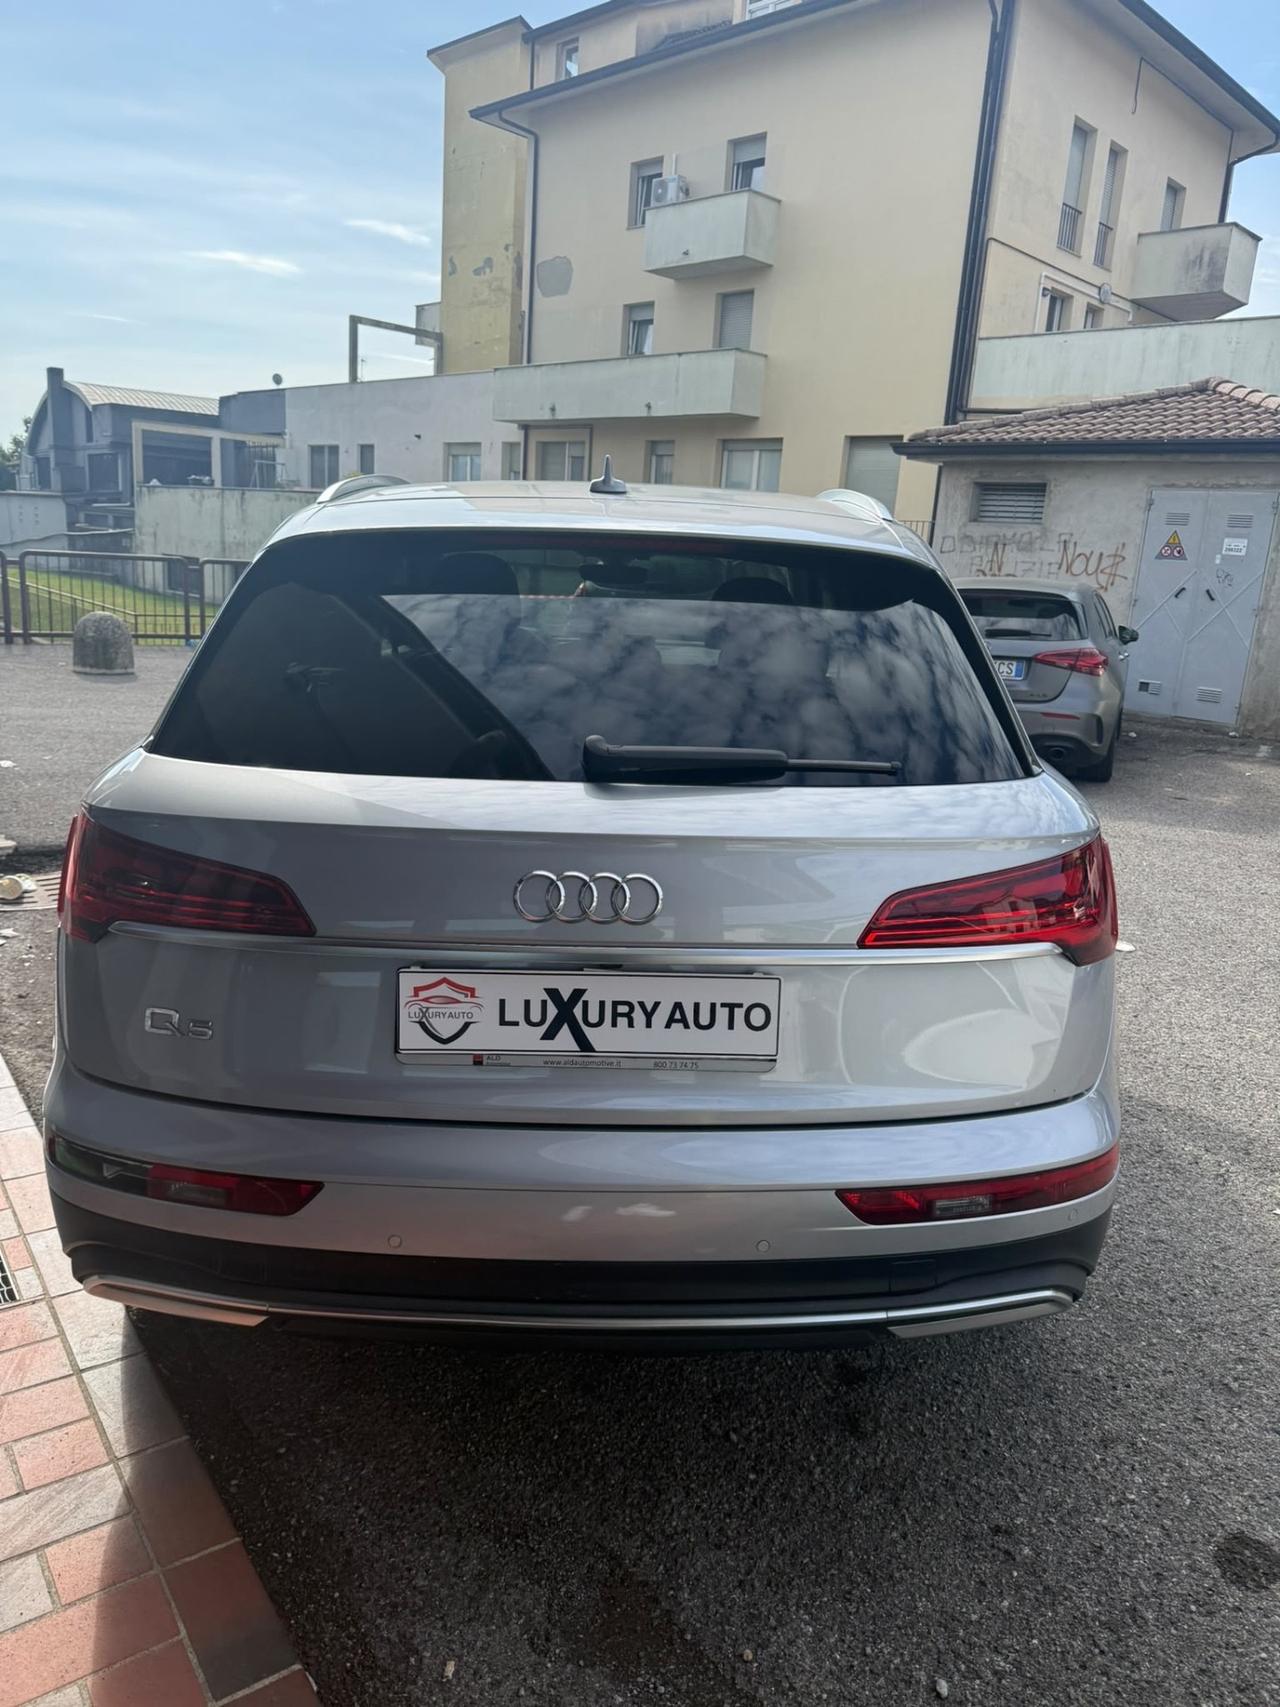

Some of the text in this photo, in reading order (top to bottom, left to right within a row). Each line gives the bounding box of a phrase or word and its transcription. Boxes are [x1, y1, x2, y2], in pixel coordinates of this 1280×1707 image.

[994, 661, 1014, 675] CS
[408, 1007, 474, 1022] LUXURYAUTO
[498, 987, 772, 1052] LUXURYAUTO
[144, 1007, 213, 1040] Q5
[543, 1058, 622, 1068] www.aldautomotive.it
[653, 1060, 667, 1068] 800
